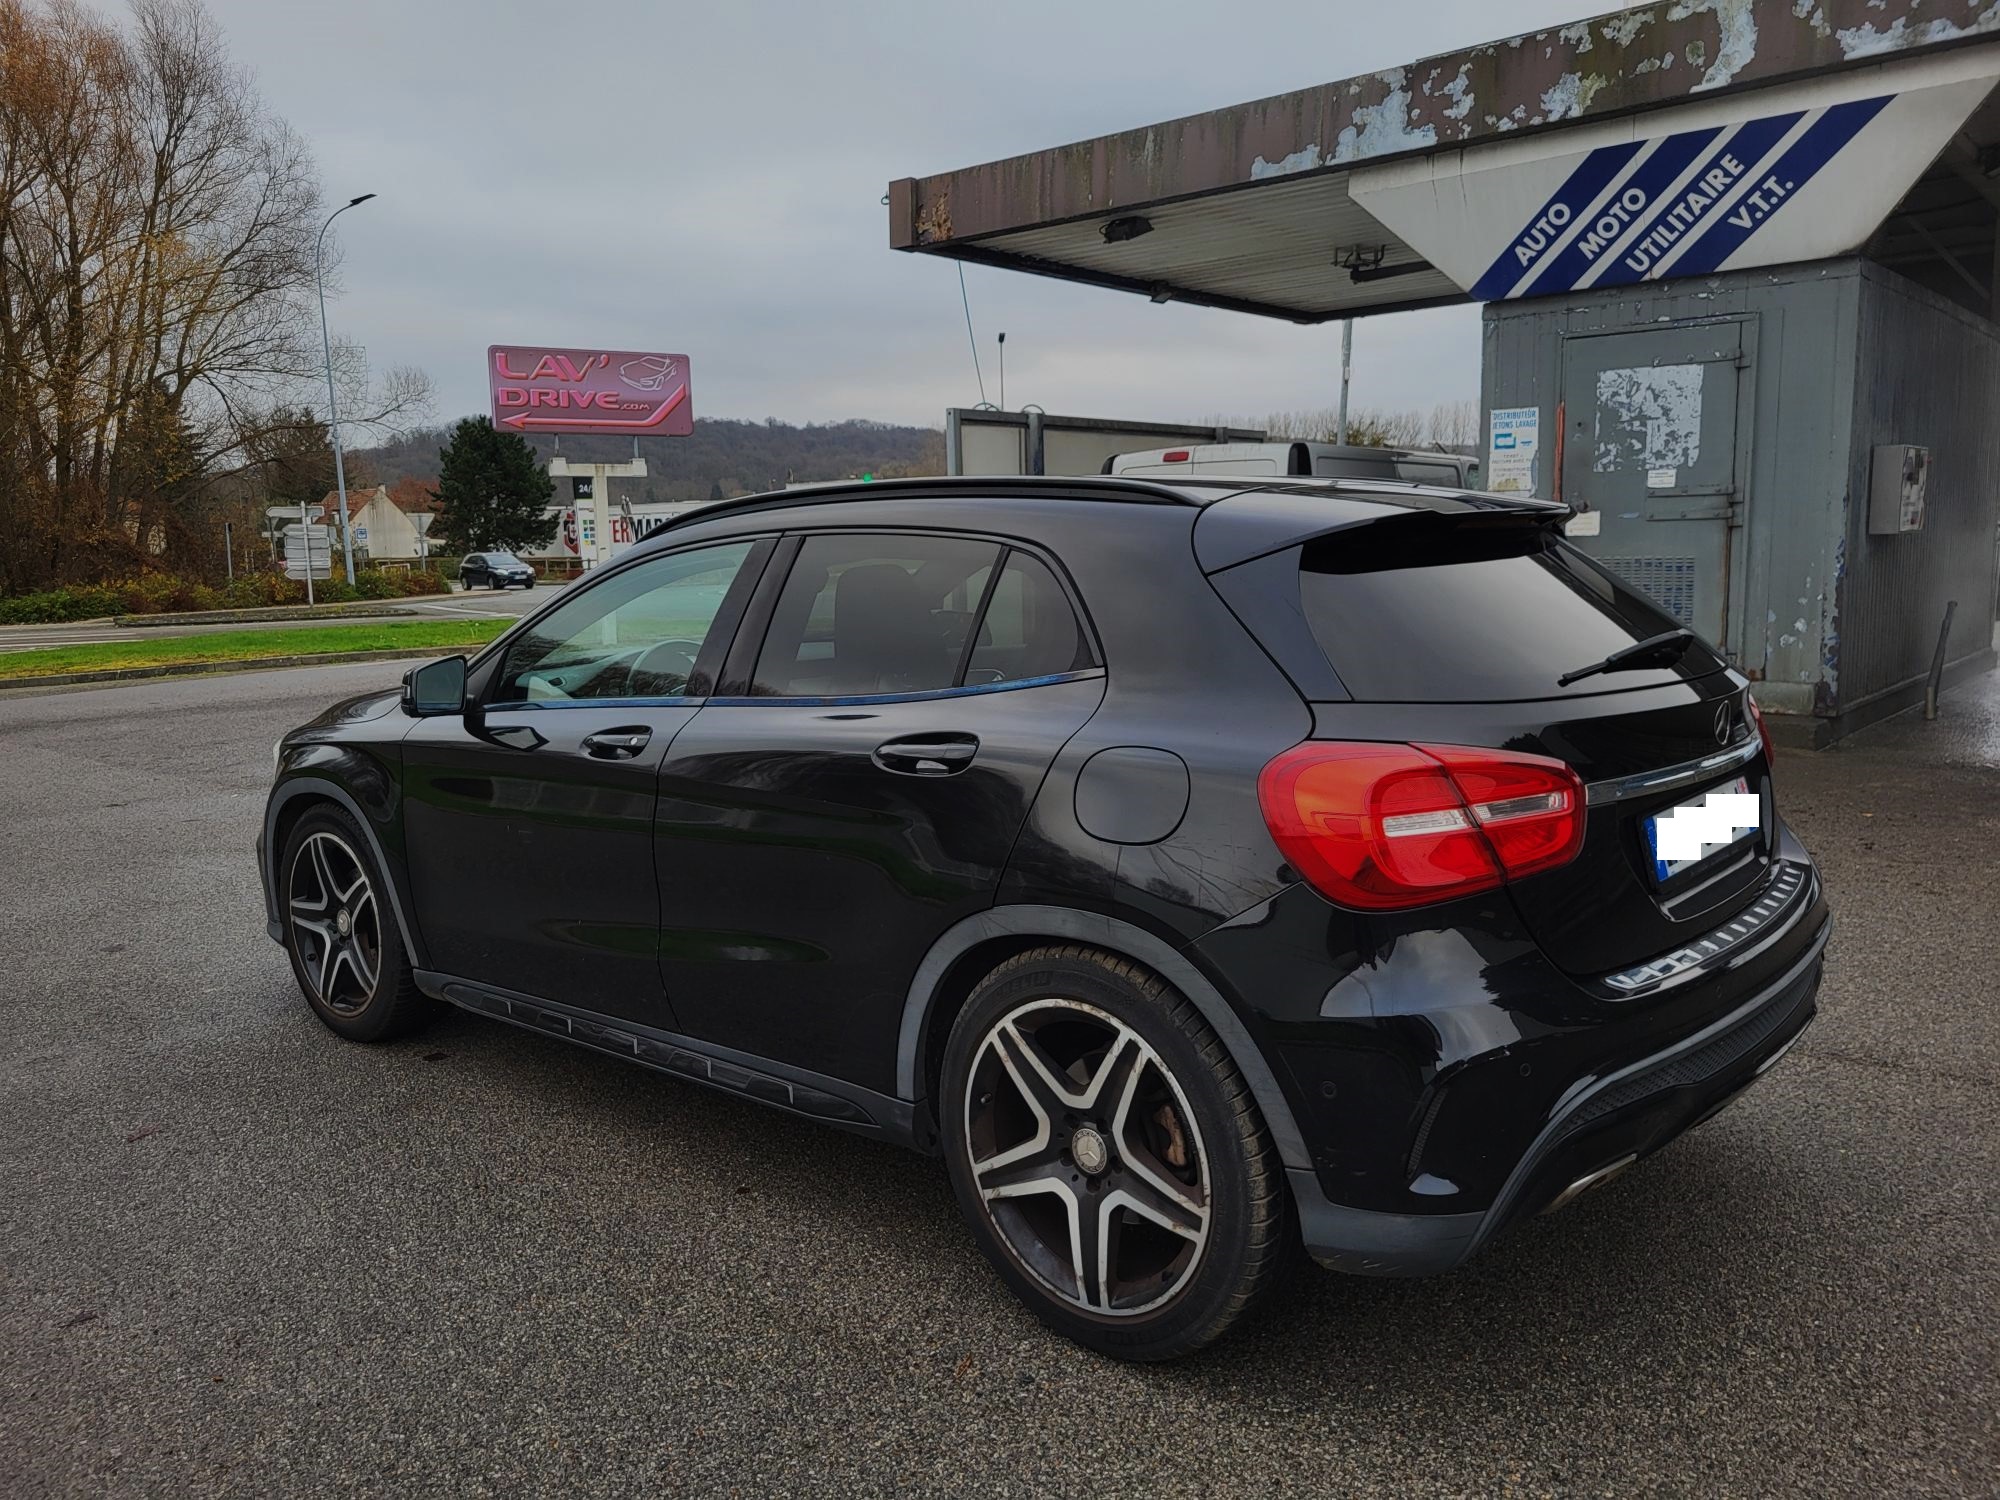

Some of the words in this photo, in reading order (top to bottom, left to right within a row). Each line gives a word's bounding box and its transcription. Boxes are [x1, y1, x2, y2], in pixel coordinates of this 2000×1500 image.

[1578, 187, 1647, 260] MOTO
[1625, 153, 1745, 273] UTILITAIRE
[1727, 175, 1794, 230] V.T.T.
[1514, 203, 1571, 267] AUTO
[495, 352, 610, 382] LAV'
[1492, 420, 1514, 430] JETONS
[1515, 419, 1537, 429] LAVAGE
[1493, 409, 1537, 421] DISTRIBUTEUR
[578, 484, 593, 493] 24/
